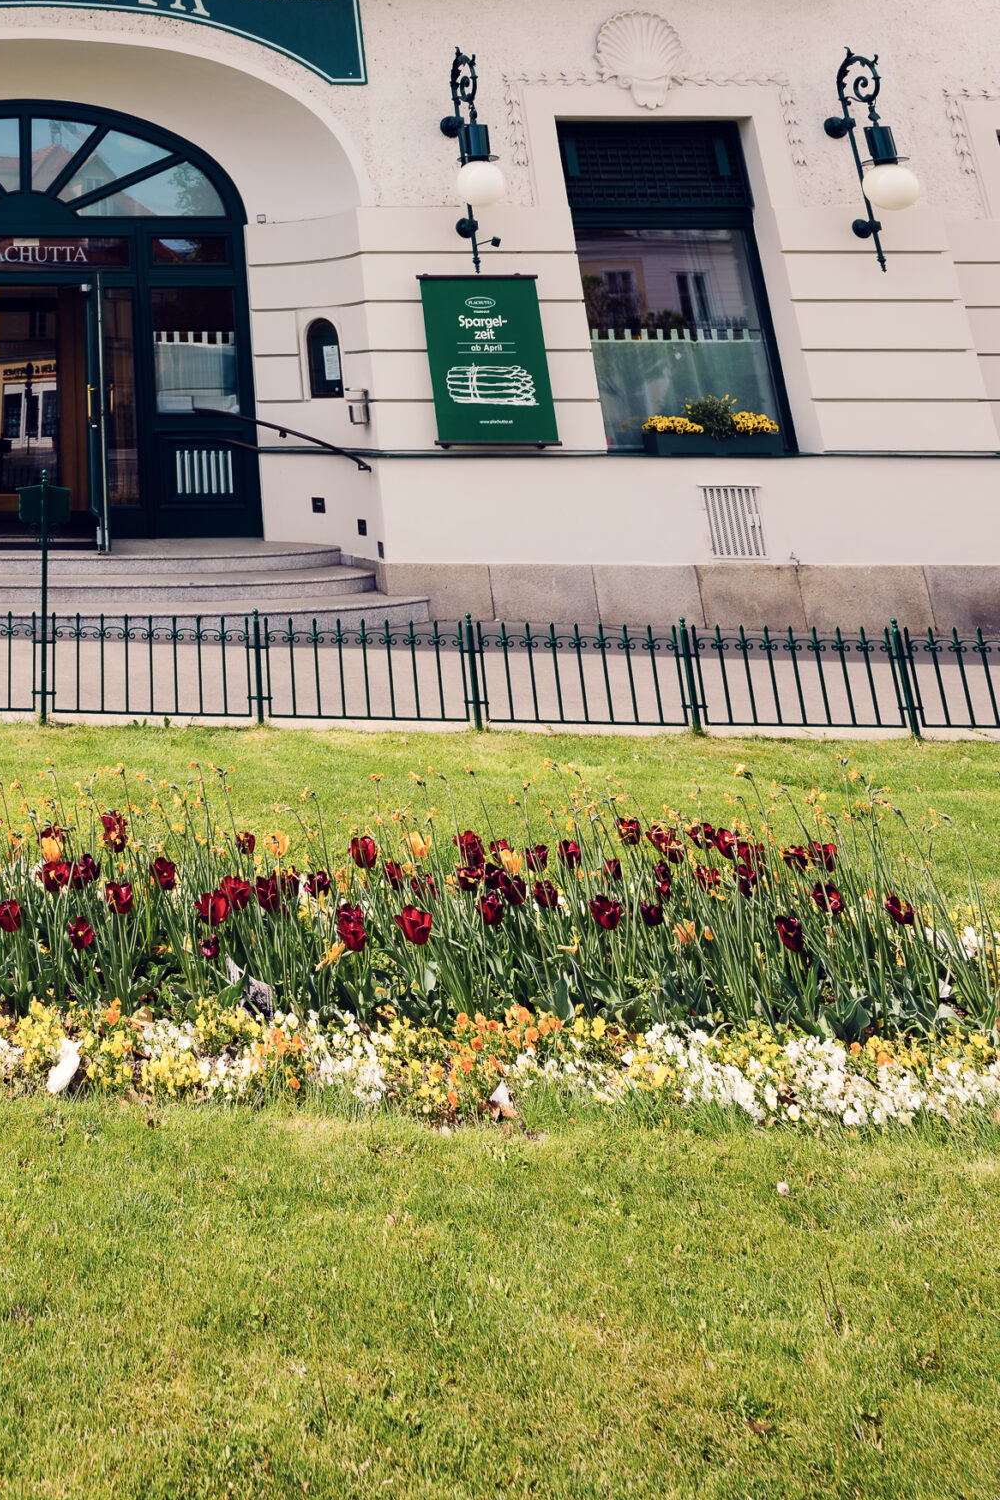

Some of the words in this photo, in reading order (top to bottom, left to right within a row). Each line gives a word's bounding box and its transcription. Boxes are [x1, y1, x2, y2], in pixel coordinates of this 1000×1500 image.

[458, 315, 508, 329] Spargel-
[474, 329, 496, 340] zeit
[471, 344, 481, 352] ab
[483, 344, 503, 353] April
